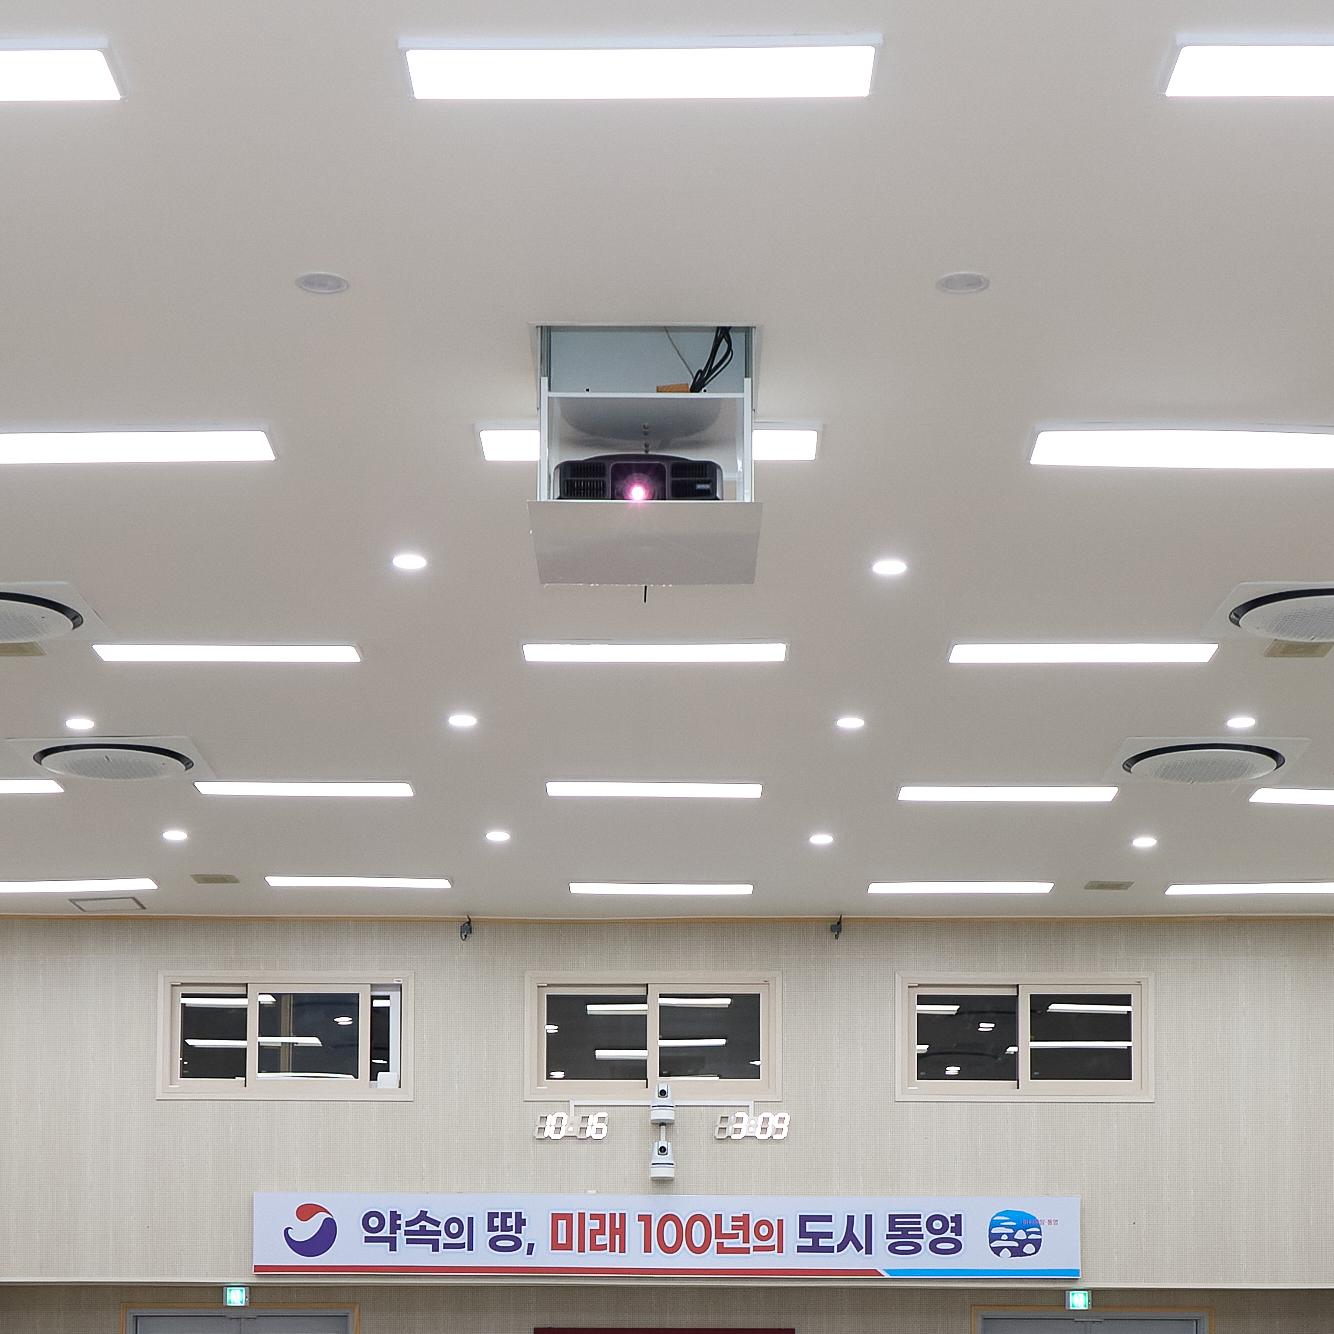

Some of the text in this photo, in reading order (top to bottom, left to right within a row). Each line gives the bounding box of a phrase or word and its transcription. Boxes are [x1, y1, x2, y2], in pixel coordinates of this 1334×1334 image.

[361, 1210, 963, 1256] 약속의 땅, 미래 100년의 도시 통영
